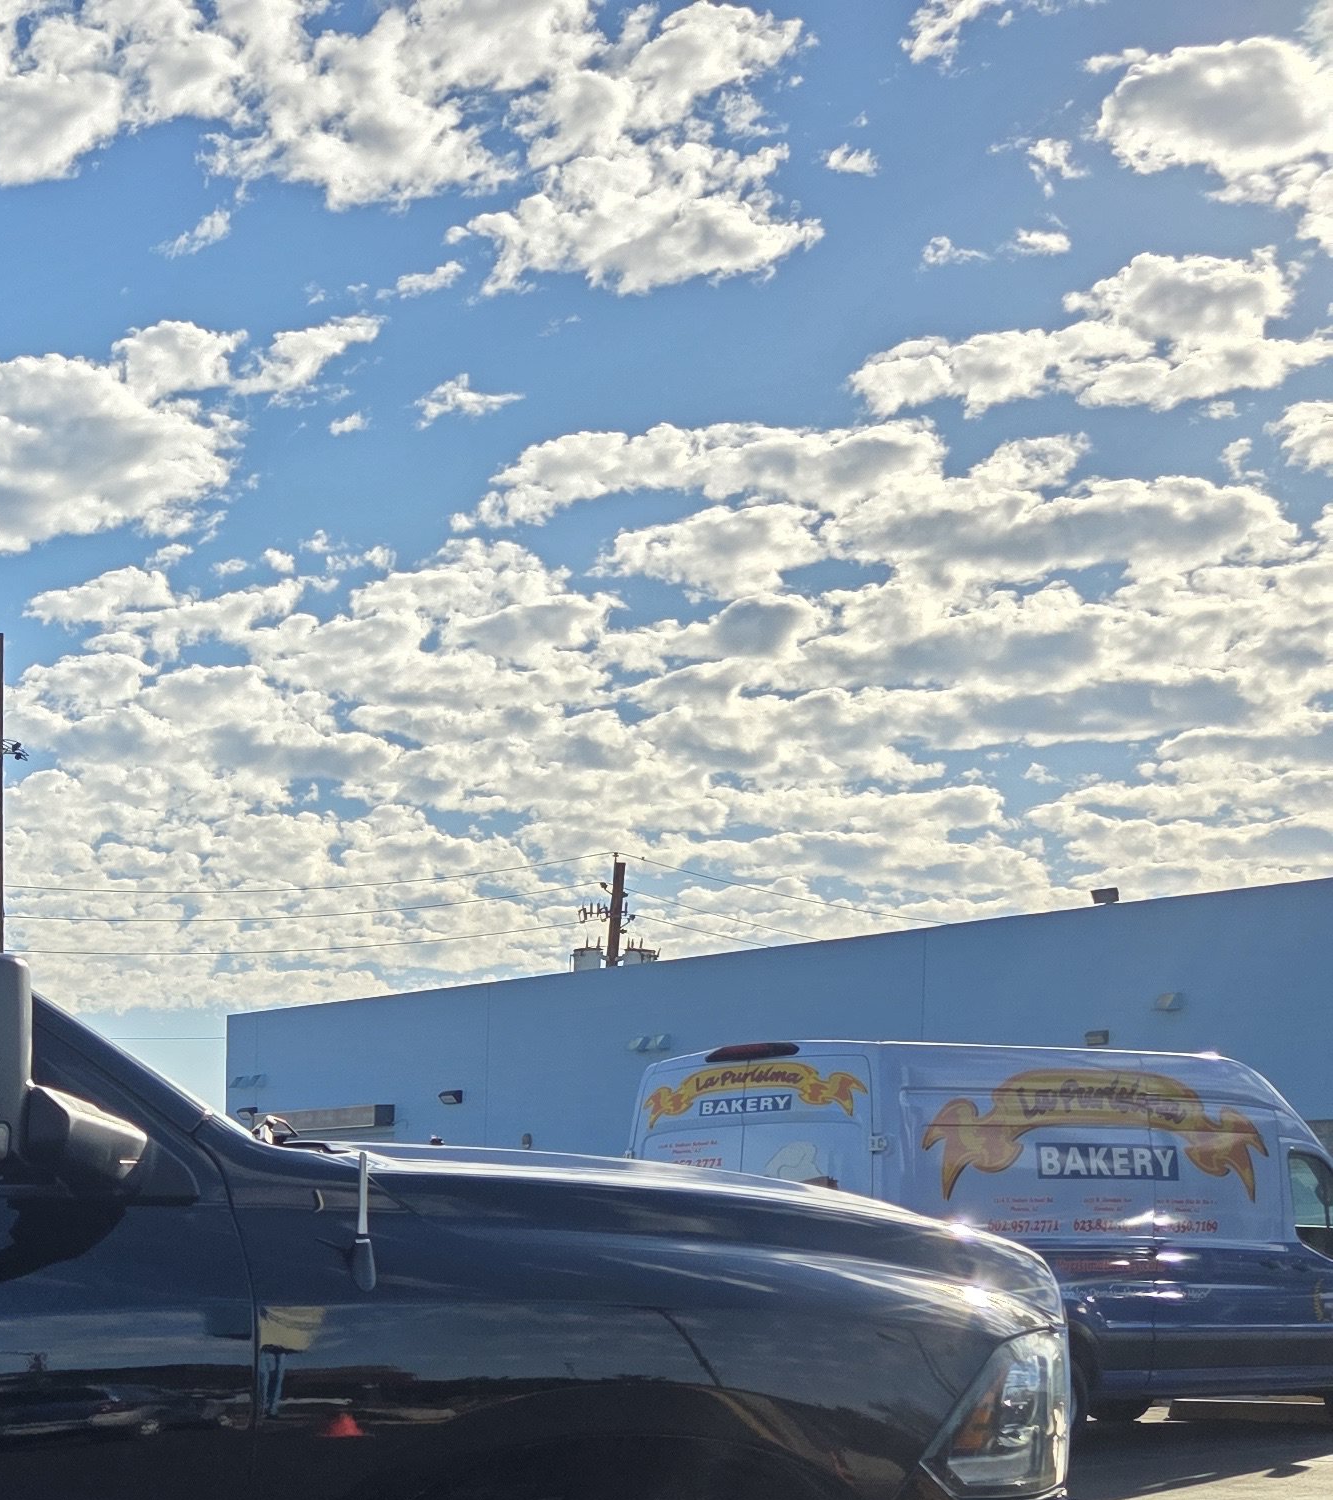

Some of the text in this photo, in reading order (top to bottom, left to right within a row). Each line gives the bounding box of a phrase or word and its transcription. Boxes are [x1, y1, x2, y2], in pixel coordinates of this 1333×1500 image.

[696, 1076, 719, 1092] La
[701, 1096, 790, 1115] BAKERY
[1040, 1146, 1174, 1177] BAKERY
[988, 1219, 1059, 1233] 602.957.2771
